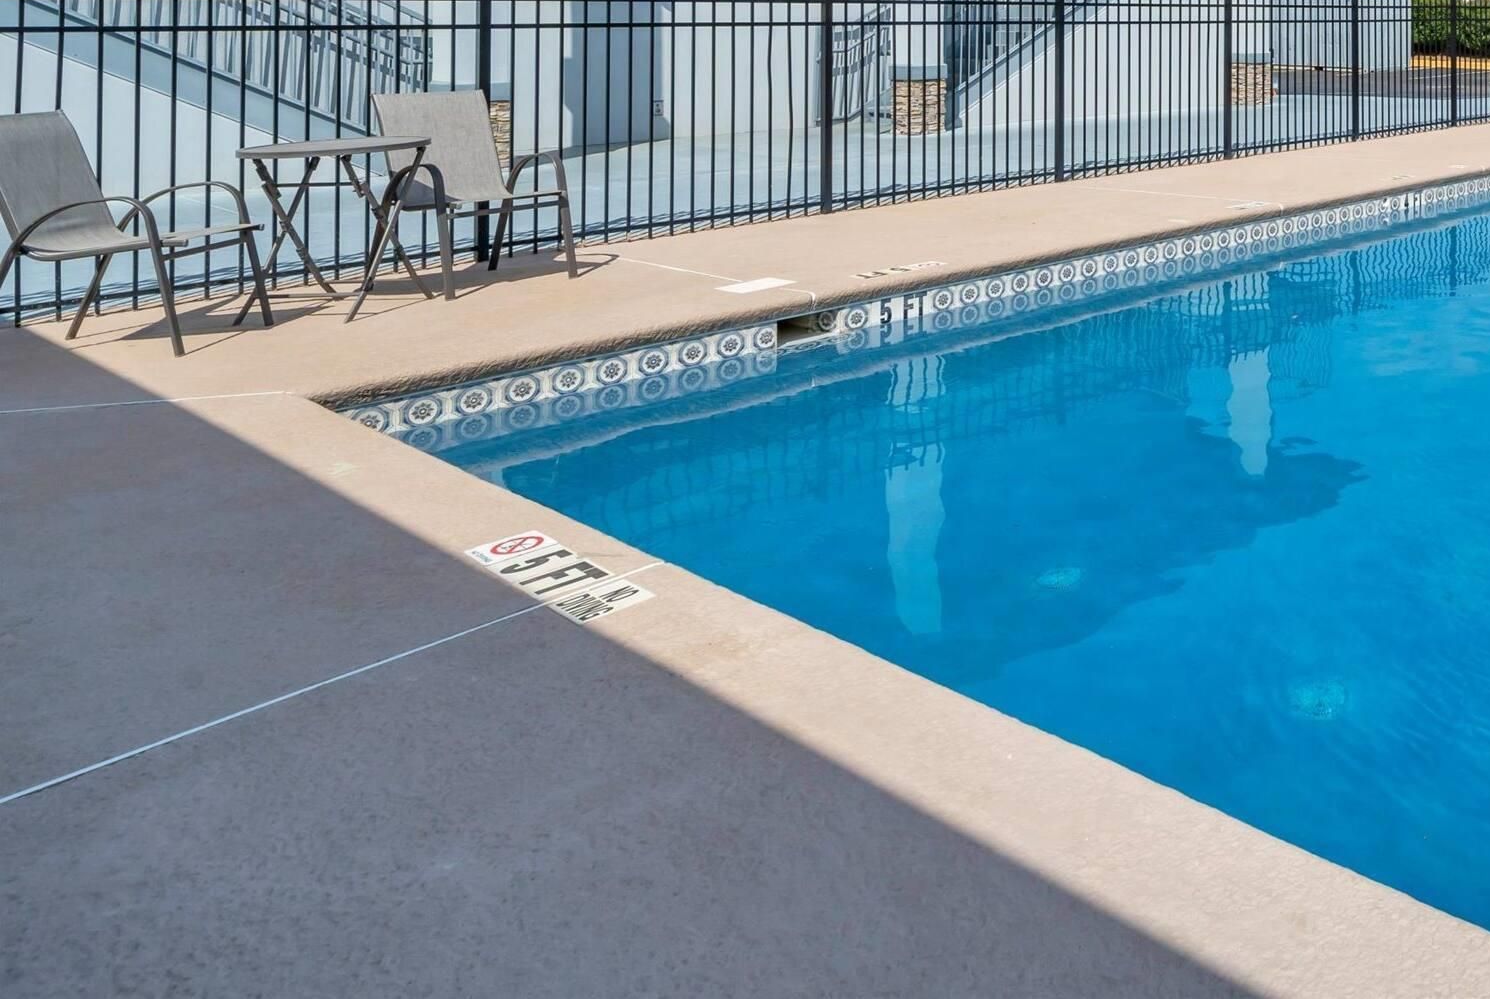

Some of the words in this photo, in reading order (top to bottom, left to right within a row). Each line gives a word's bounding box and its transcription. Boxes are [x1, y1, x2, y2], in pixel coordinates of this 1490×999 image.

[880, 297, 892, 324] 5
[903, 291, 928, 319] FT
[500, 549, 573, 575] 5
[519, 561, 609, 595] FT
[555, 593, 614, 621] DIVING
[599, 585, 639, 603] NO
